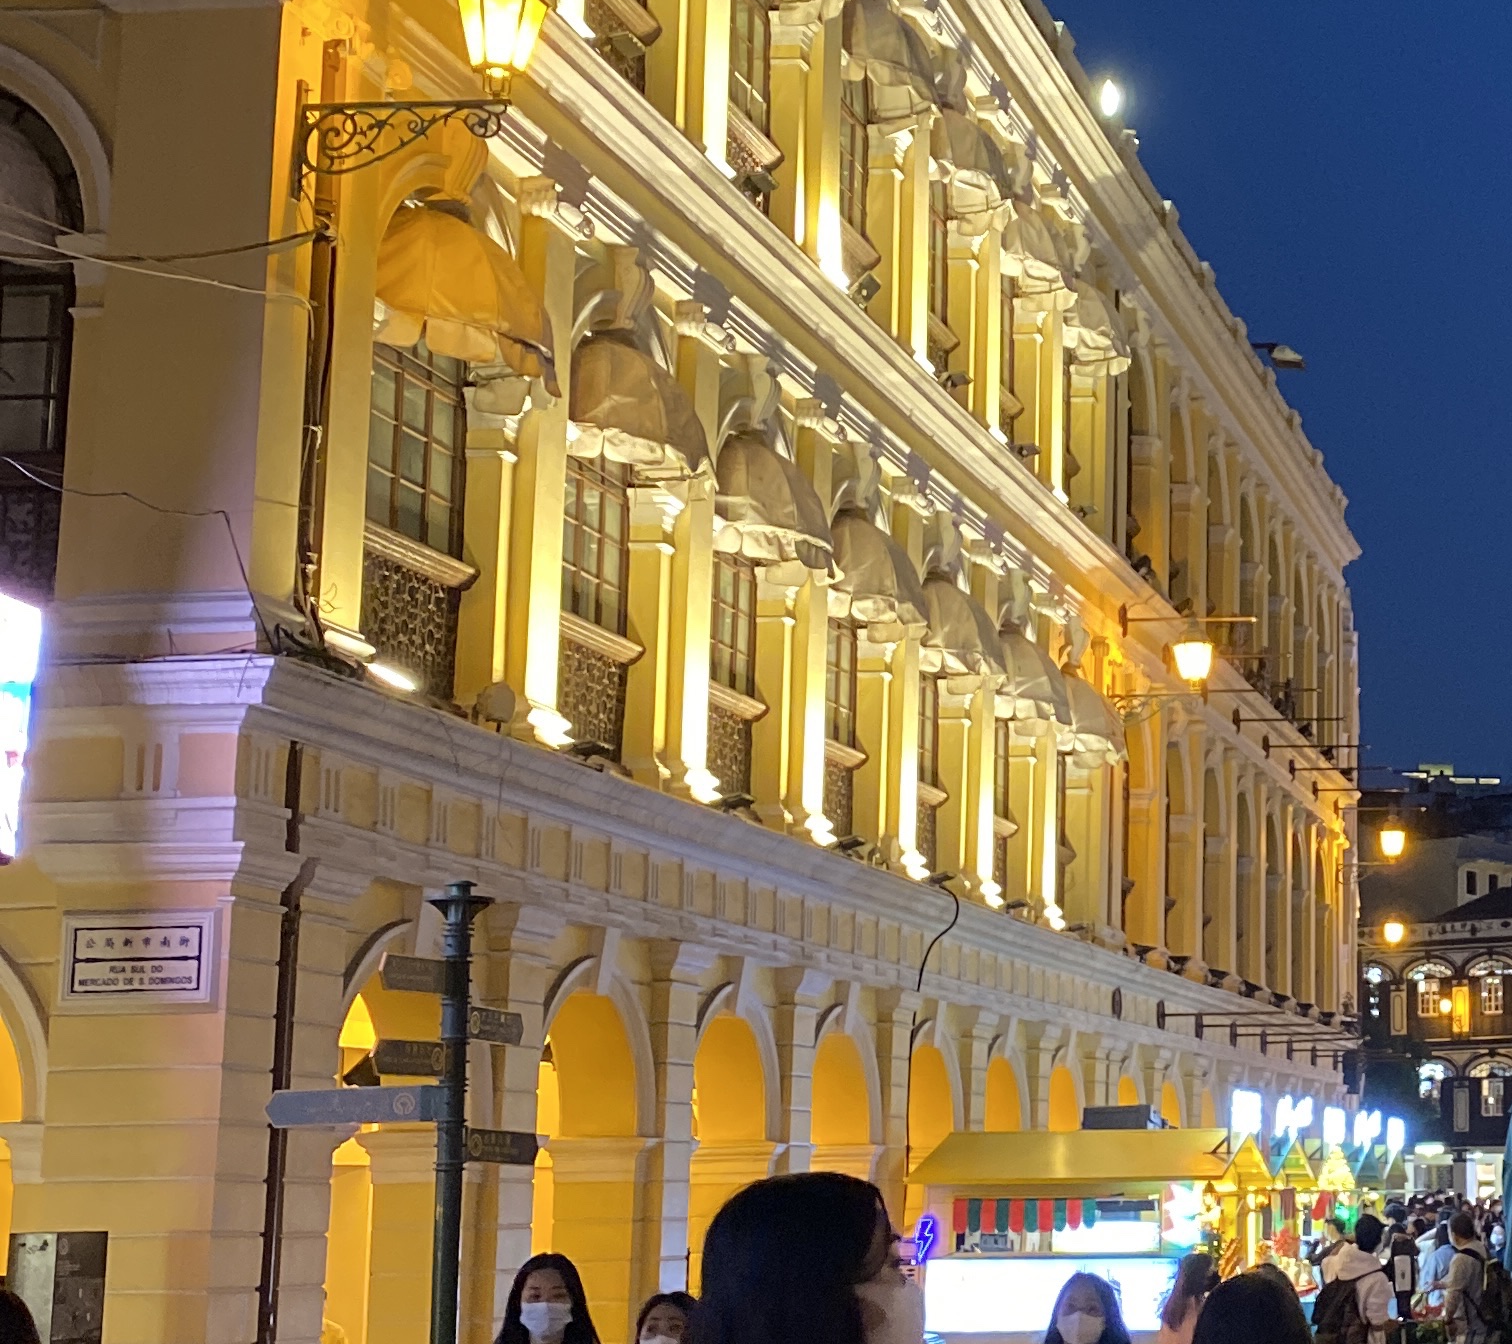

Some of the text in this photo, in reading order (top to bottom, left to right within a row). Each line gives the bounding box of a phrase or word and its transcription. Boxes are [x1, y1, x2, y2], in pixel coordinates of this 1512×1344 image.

[109, 964, 163, 974] RUA SUL DO
[79, 977, 119, 987] MERCADO
[123, 977, 134, 986] DE
[148, 975, 193, 986] DOMINGOS
